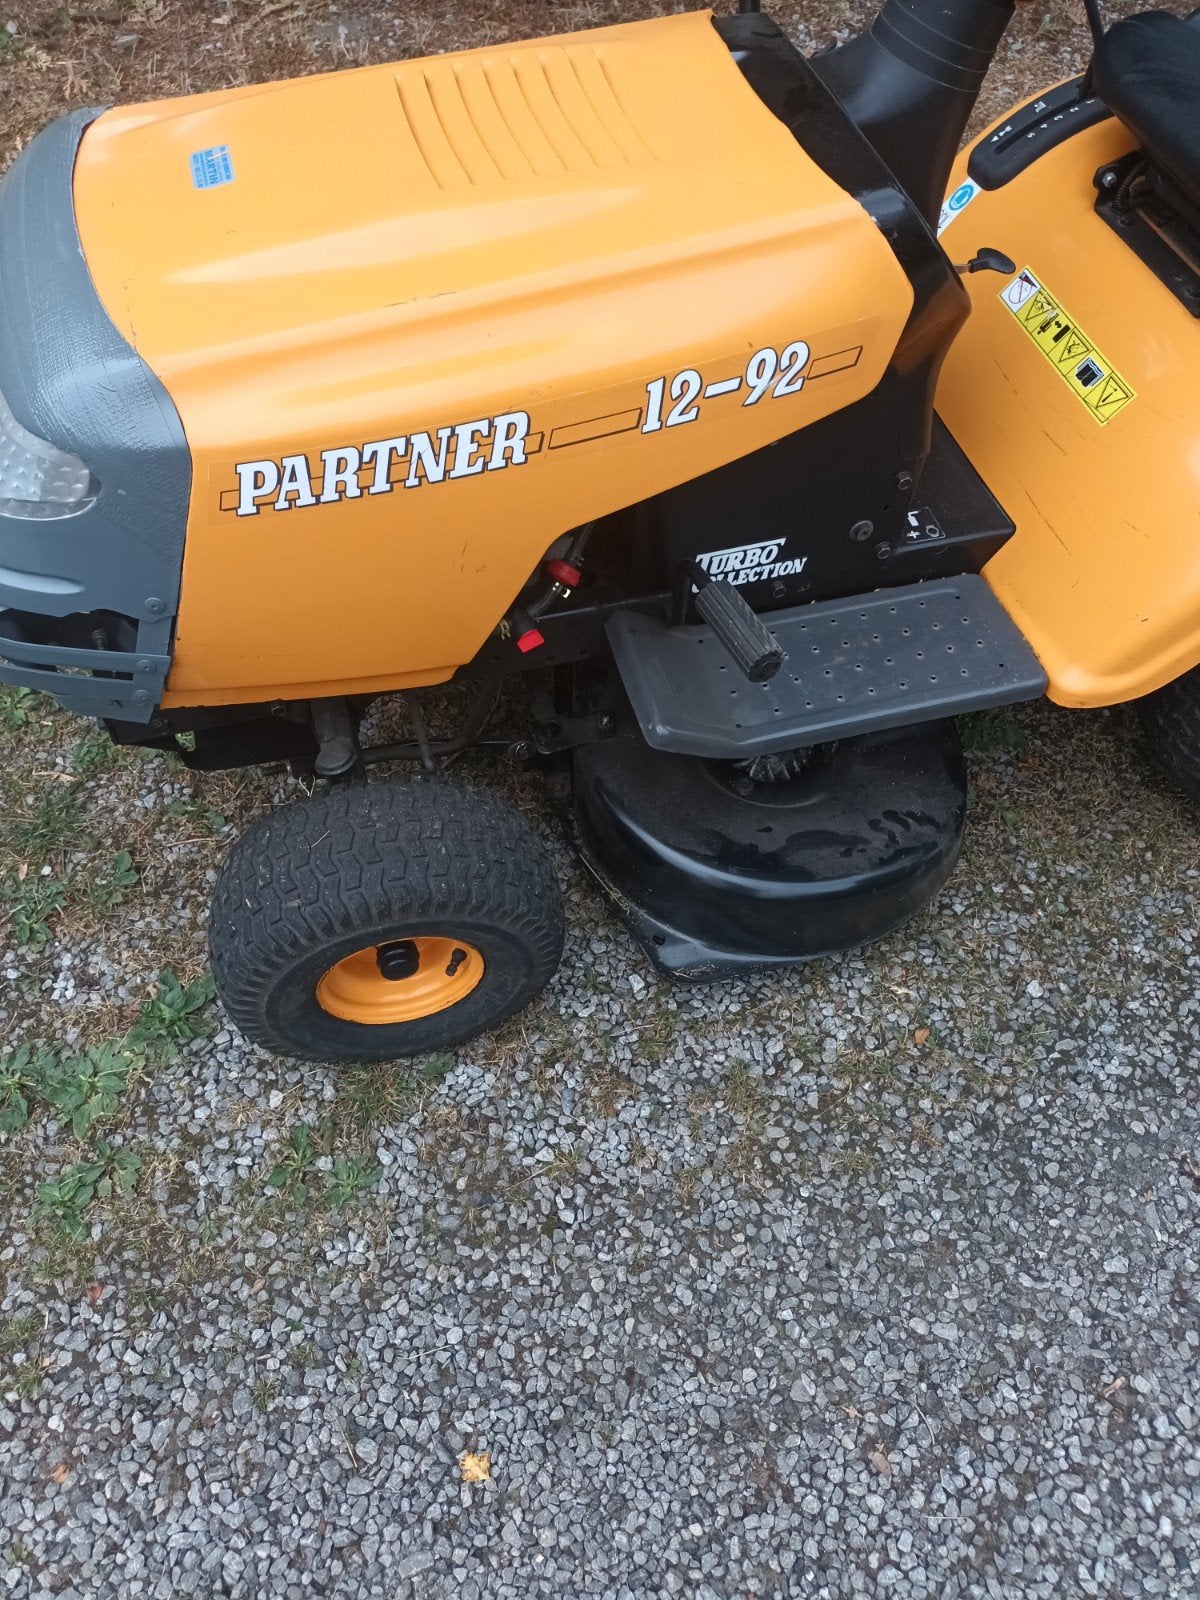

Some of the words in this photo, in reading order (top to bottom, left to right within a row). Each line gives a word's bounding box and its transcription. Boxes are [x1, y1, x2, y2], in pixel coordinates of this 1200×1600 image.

[204, 149, 220, 185] MARTIN
[235, 410, 530, 517] PARTNER
[640, 339, 810, 435] 12-92
[692, 556, 808, 594] LECTION
[695, 537, 787, 575] TURBO
